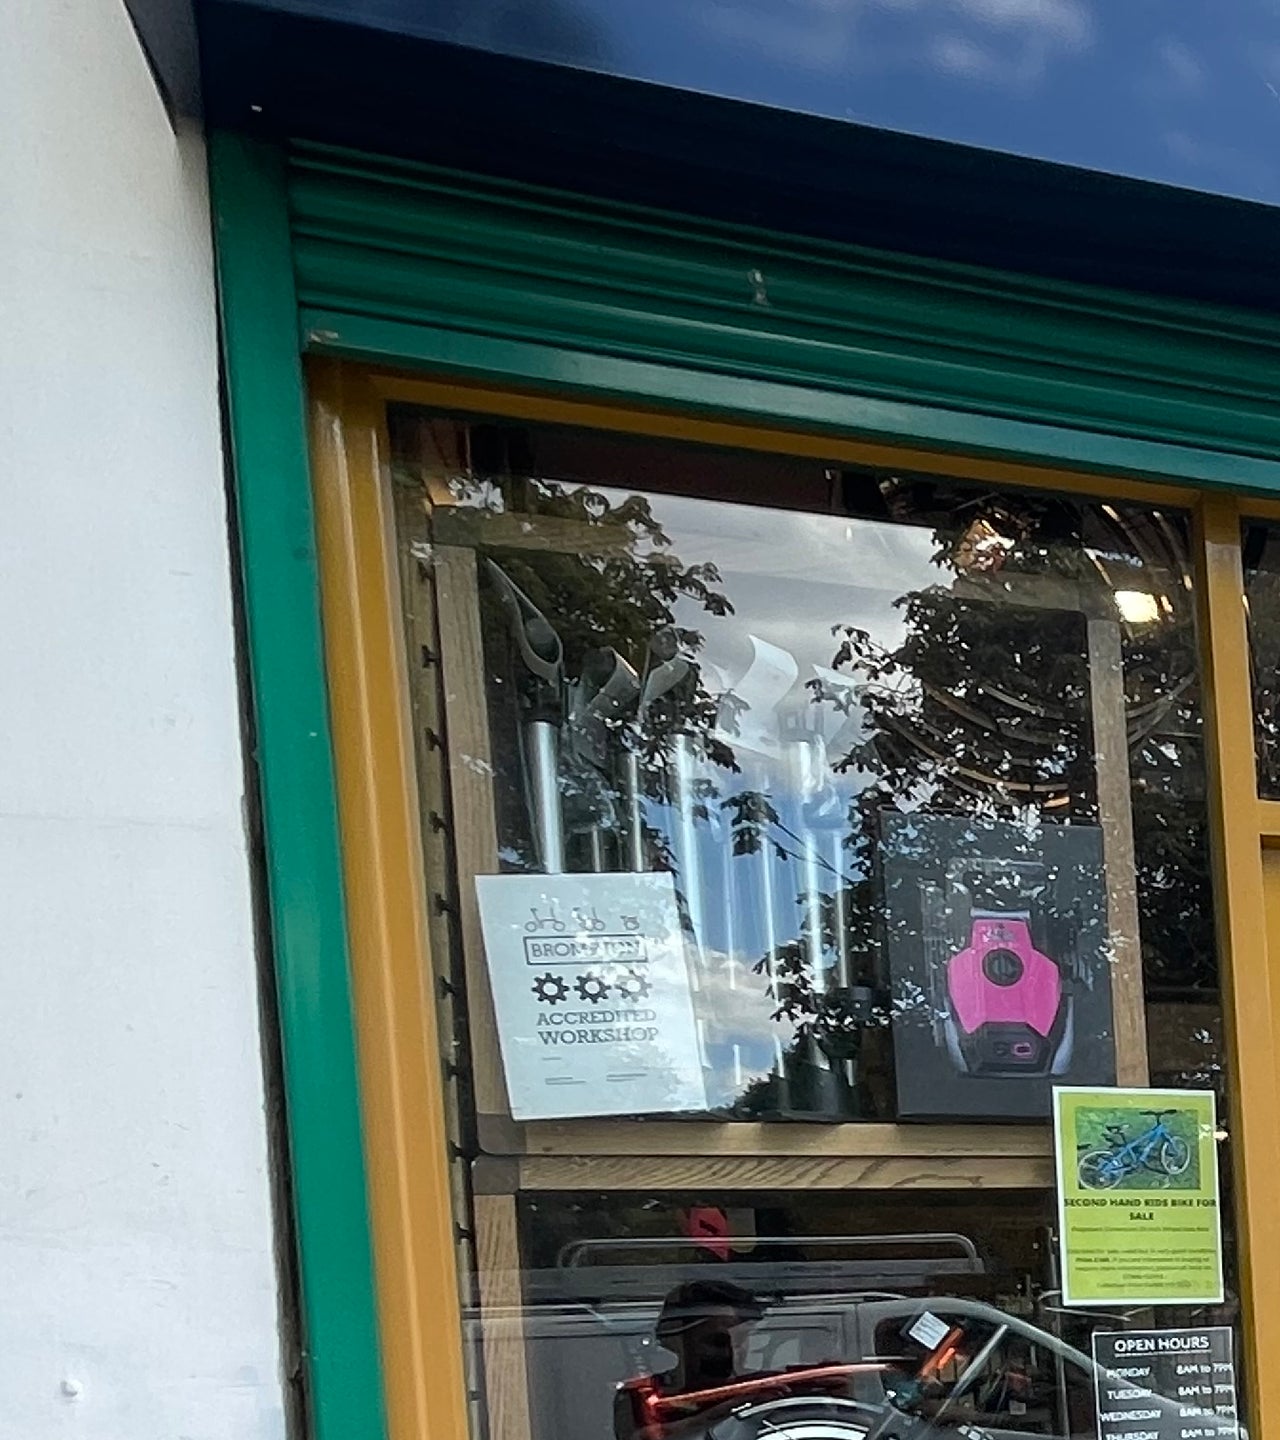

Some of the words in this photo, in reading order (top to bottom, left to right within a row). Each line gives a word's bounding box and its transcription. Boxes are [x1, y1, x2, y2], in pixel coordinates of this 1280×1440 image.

[536, 1009, 657, 1026] ACCREDITED
[537, 1027, 660, 1045] WORKSHOP
[1064, 1199, 1107, 1207] SECOND
[1110, 1199, 1141, 1207] HAND
[1144, 1199, 1168, 1207] KIDS
[1171, 1199, 1192, 1207] BIKE
[1197, 1199, 1217, 1207] FOR
[1129, 1212, 1154, 1220] SALE
[1115, 1339, 1155, 1352] OPEN
[1158, 1336, 1210, 1350] HOURS
[1106, 1367, 1151, 1379] MONDAY
[1107, 1389, 1152, 1400] TUESDAY
[1100, 1410, 1162, 1422] WEDNESDAY
